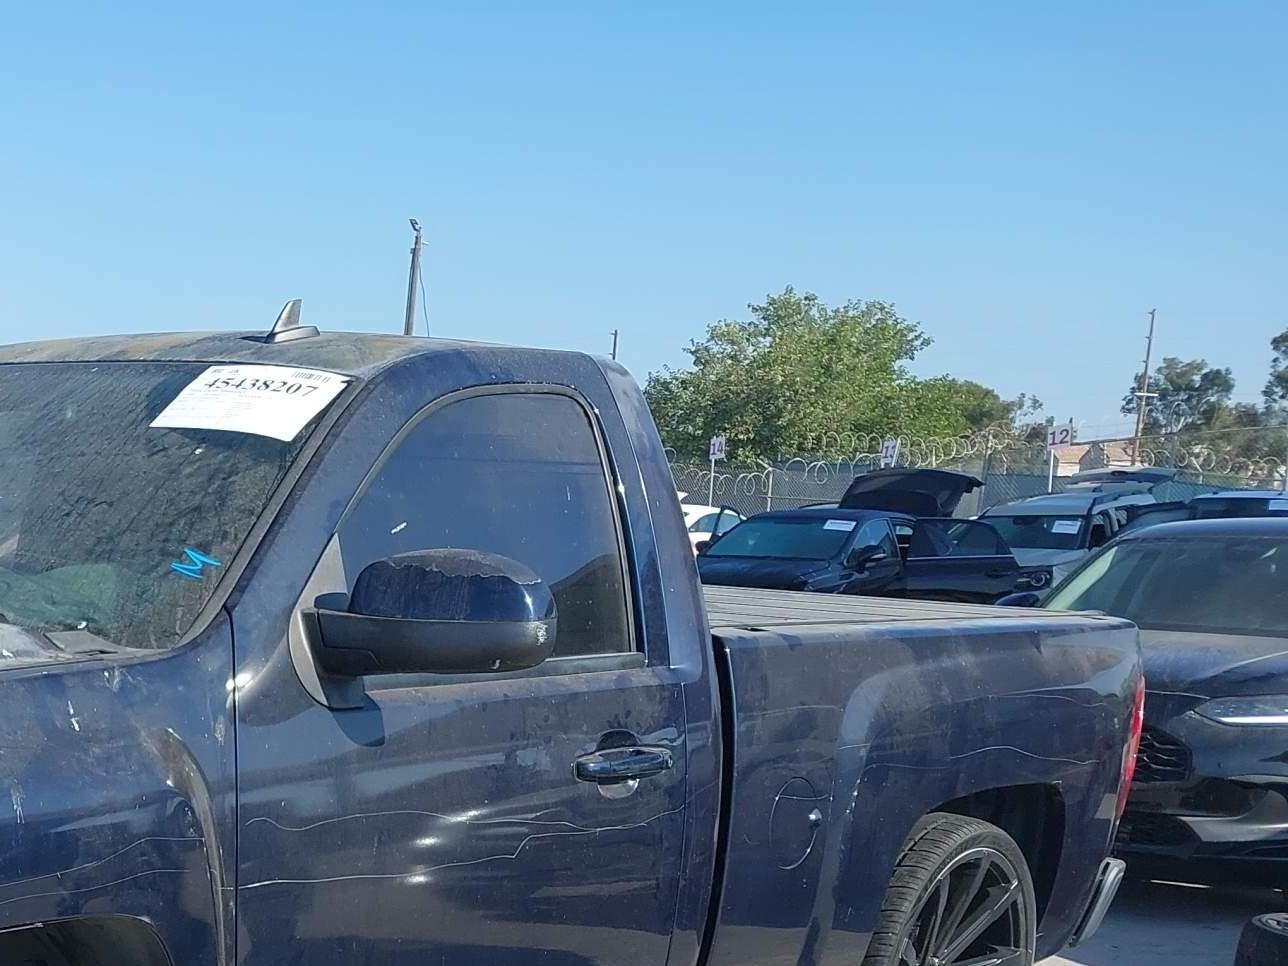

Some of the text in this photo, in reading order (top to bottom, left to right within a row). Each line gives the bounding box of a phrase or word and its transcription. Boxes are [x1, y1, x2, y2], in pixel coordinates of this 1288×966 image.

[204, 377, 319, 396] 45438207
[1048, 428, 1070, 446] 12
[711, 440, 724, 456] 14
